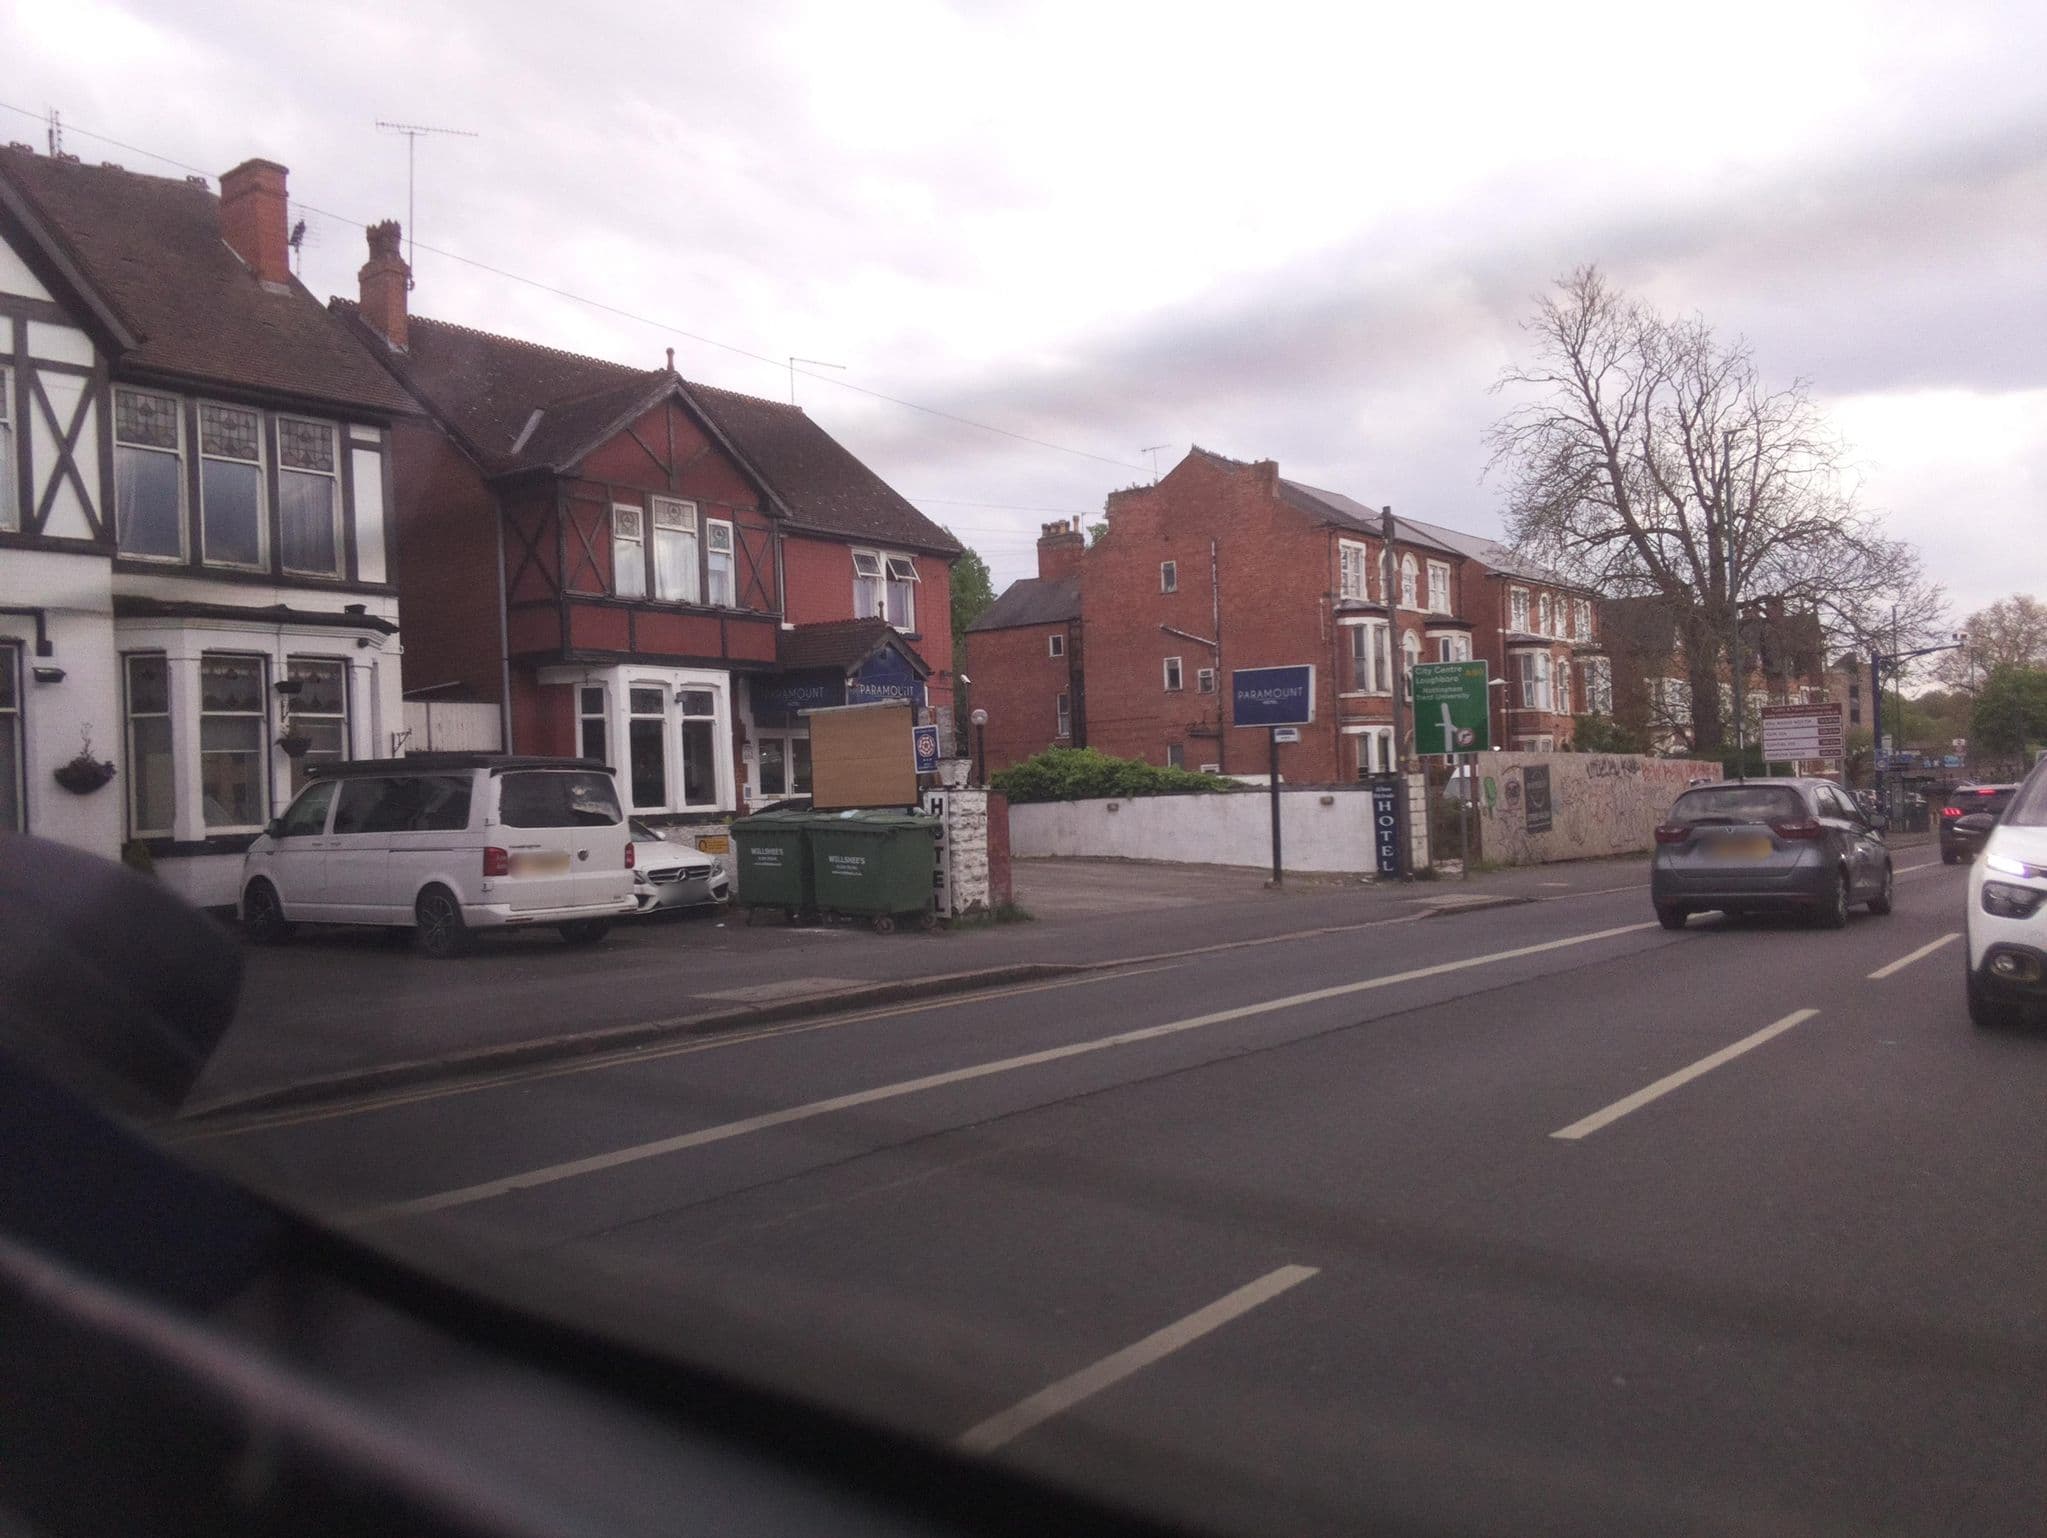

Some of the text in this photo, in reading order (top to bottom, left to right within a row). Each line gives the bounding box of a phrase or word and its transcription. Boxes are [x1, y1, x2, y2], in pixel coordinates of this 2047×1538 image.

[1434, 665, 1463, 674] Centre
[1238, 686, 1303, 700] PARAMOUNT
[1378, 800, 1395, 872] HOTEL
